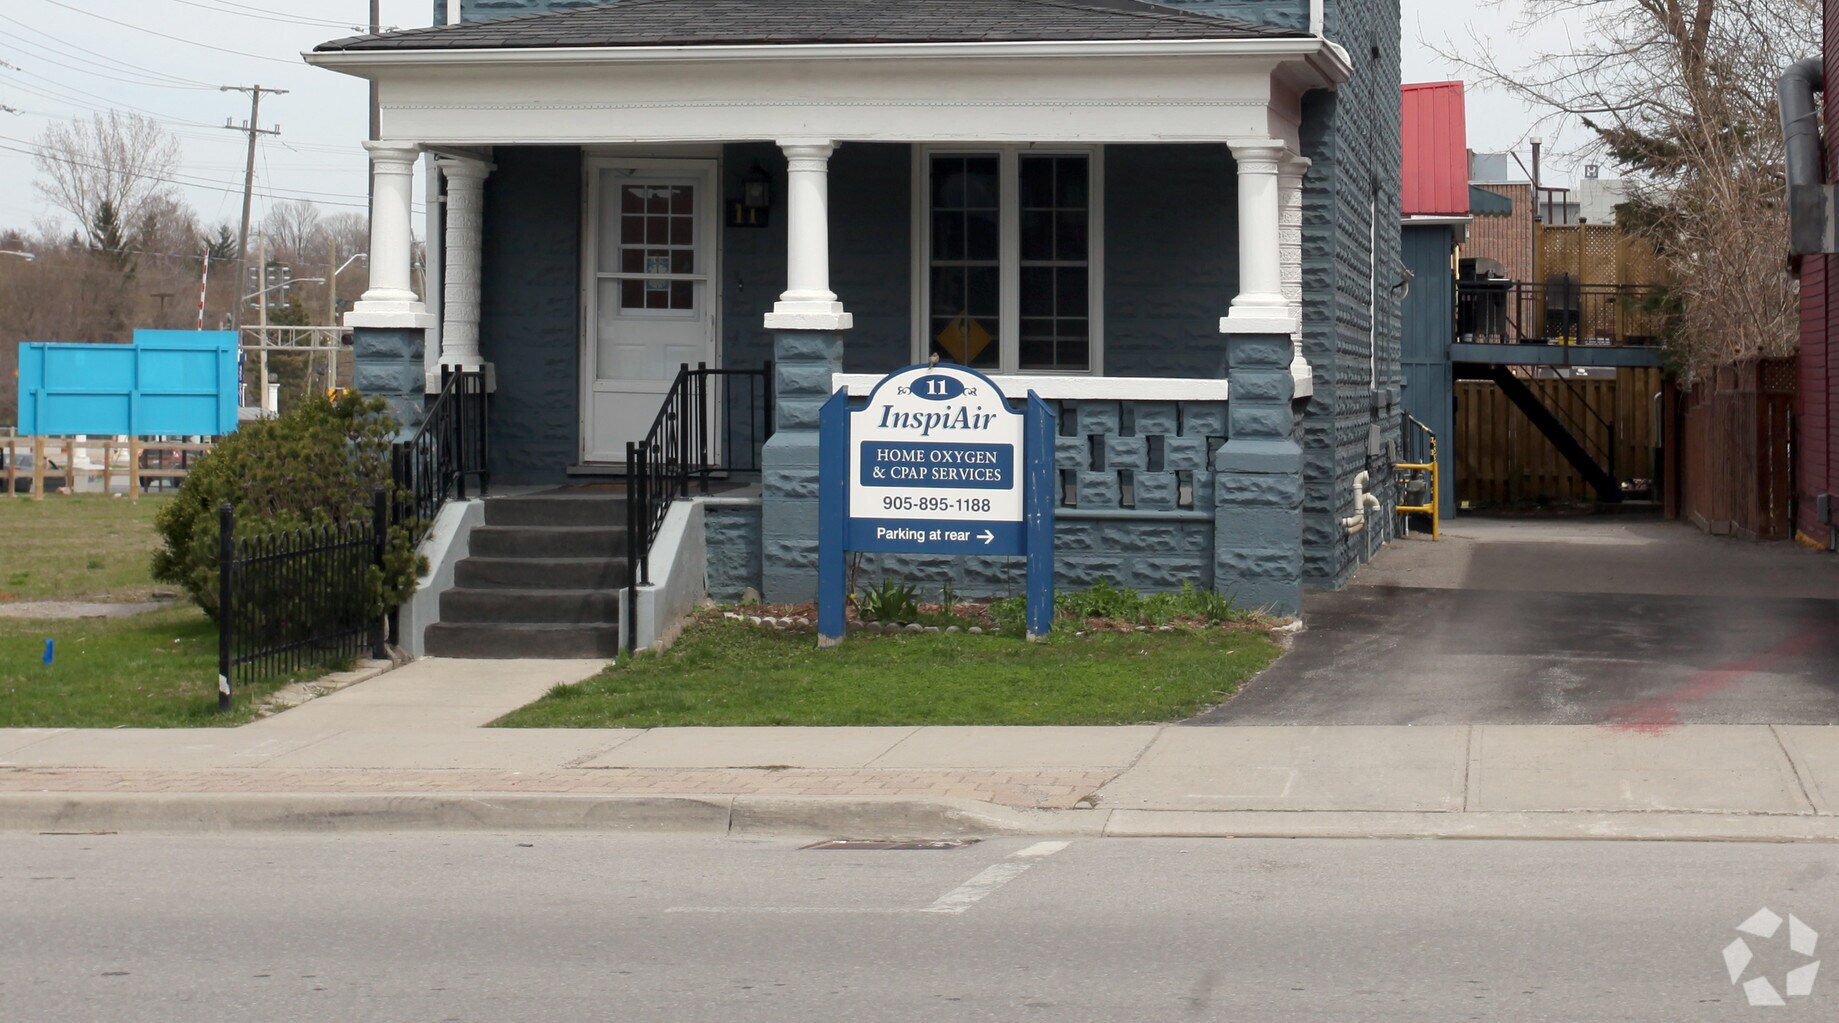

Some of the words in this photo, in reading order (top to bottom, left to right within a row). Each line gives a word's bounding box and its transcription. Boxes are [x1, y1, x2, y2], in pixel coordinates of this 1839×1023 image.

[926, 379, 948, 395] 11
[878, 405, 997, 436] InspiAir
[877, 449, 925, 462] HOME
[930, 450, 997, 464] OXYGEN
[873, 466, 886, 478] &
[890, 466, 928, 479] CPAP
[931, 467, 1001, 481] SERVICES
[883, 496, 991, 512] 905-895-1188
[877, 527, 925, 543] Parking
[929, 529, 941, 540] at
[945, 530, 970, 541] rear
